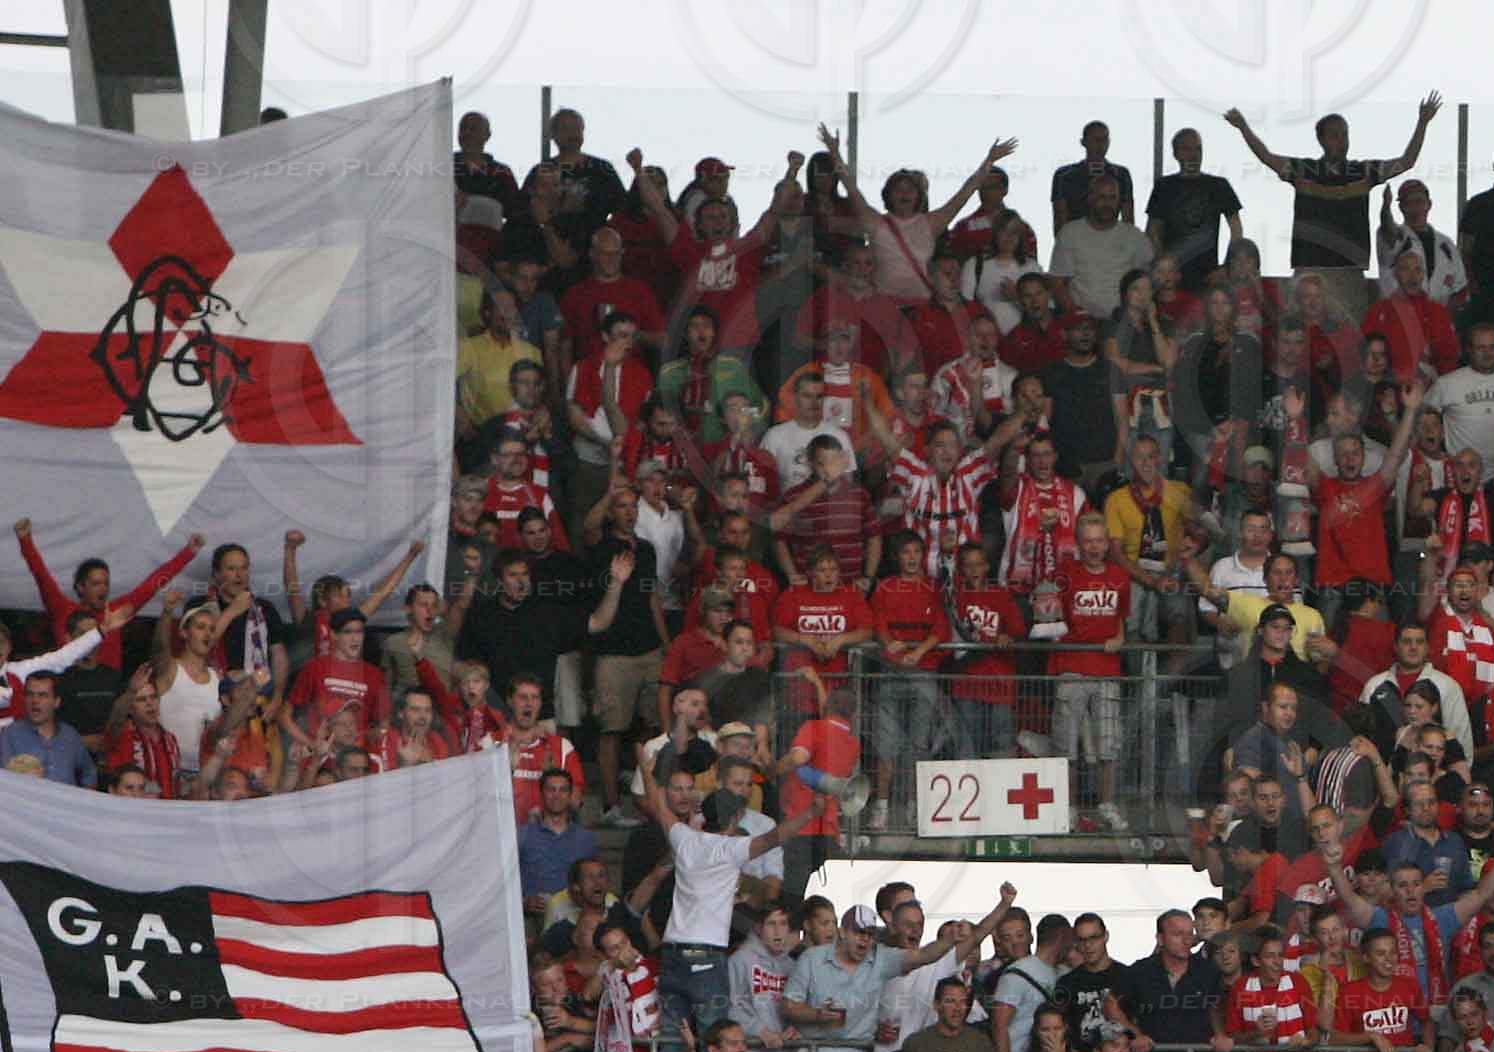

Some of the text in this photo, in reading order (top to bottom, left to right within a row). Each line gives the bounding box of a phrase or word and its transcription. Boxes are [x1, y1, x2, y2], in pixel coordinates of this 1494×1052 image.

[931, 774, 981, 822] 22
[48, 897, 202, 954] G.A.
[104, 955, 182, 1002] K.
